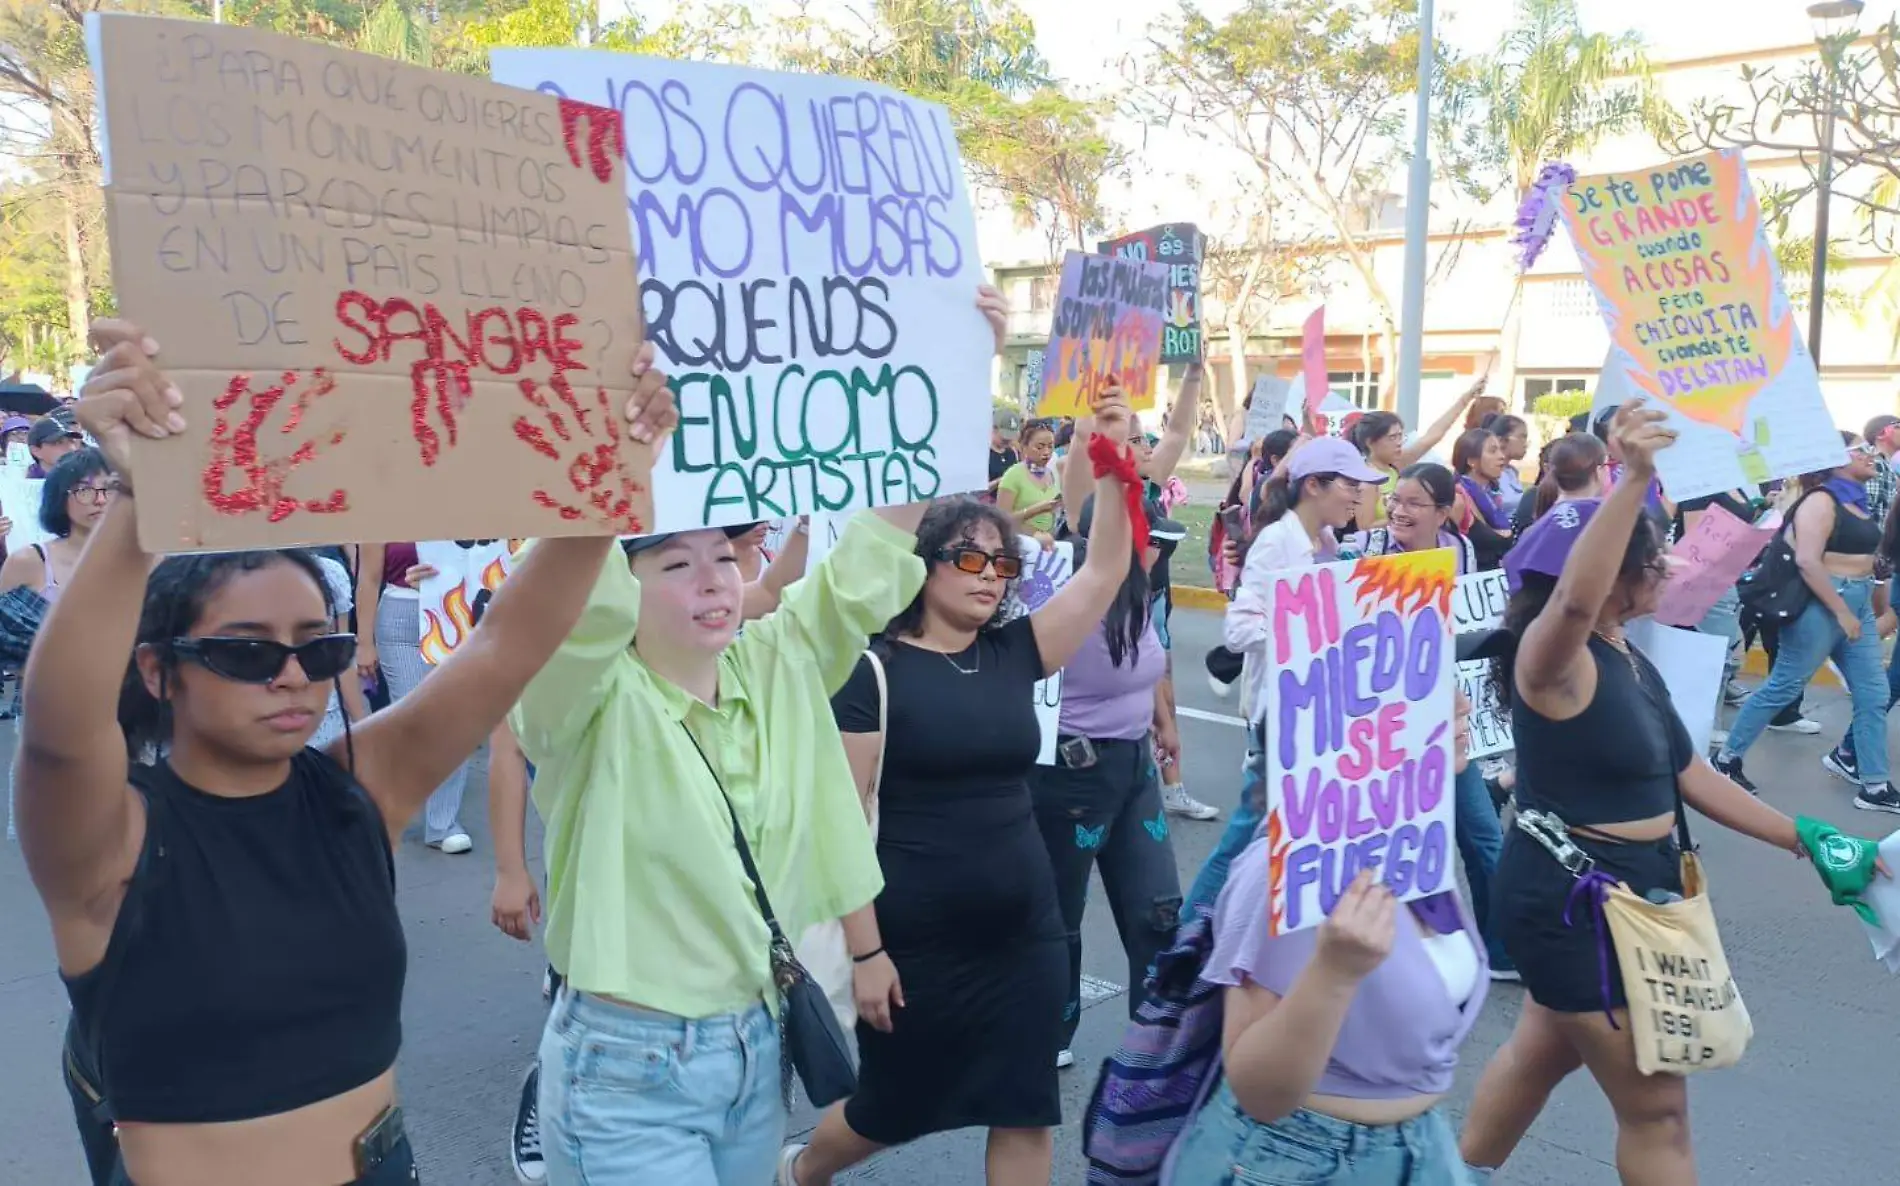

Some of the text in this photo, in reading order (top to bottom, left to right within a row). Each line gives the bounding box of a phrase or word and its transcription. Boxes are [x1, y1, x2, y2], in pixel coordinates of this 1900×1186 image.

[130, 97, 571, 204] LOS MONUMENTOS
[418, 83, 556, 147] QUIERES
[725, 81, 955, 200] QUIEREN
[201, 158, 433, 241] PAREDES
[451, 204, 610, 266] LIMPIAS
[628, 187, 962, 279] MO MUSAS
[1588, 192, 1722, 246] GRANDE
[157, 225, 230, 274] EN
[256, 228, 325, 276] UN
[457, 250, 588, 309] LLENO
[1623, 250, 1732, 295] ACOSAS
[222, 289, 307, 347] DE
[788, 274, 898, 359] NOS
[1634, 301, 1759, 345] CHIQUITA
[772, 362, 939, 460] COMO
[1656, 354, 1769, 397] DELATAN
[703, 445, 942, 527] ARTISTAS
[1273, 567, 1340, 665] MI
[1278, 606, 1443, 770] MIEDO
[1282, 719, 1449, 845] VOLVIÓ
[1337, 701, 1408, 782] SE
[1285, 820, 1446, 930] FUEGO
